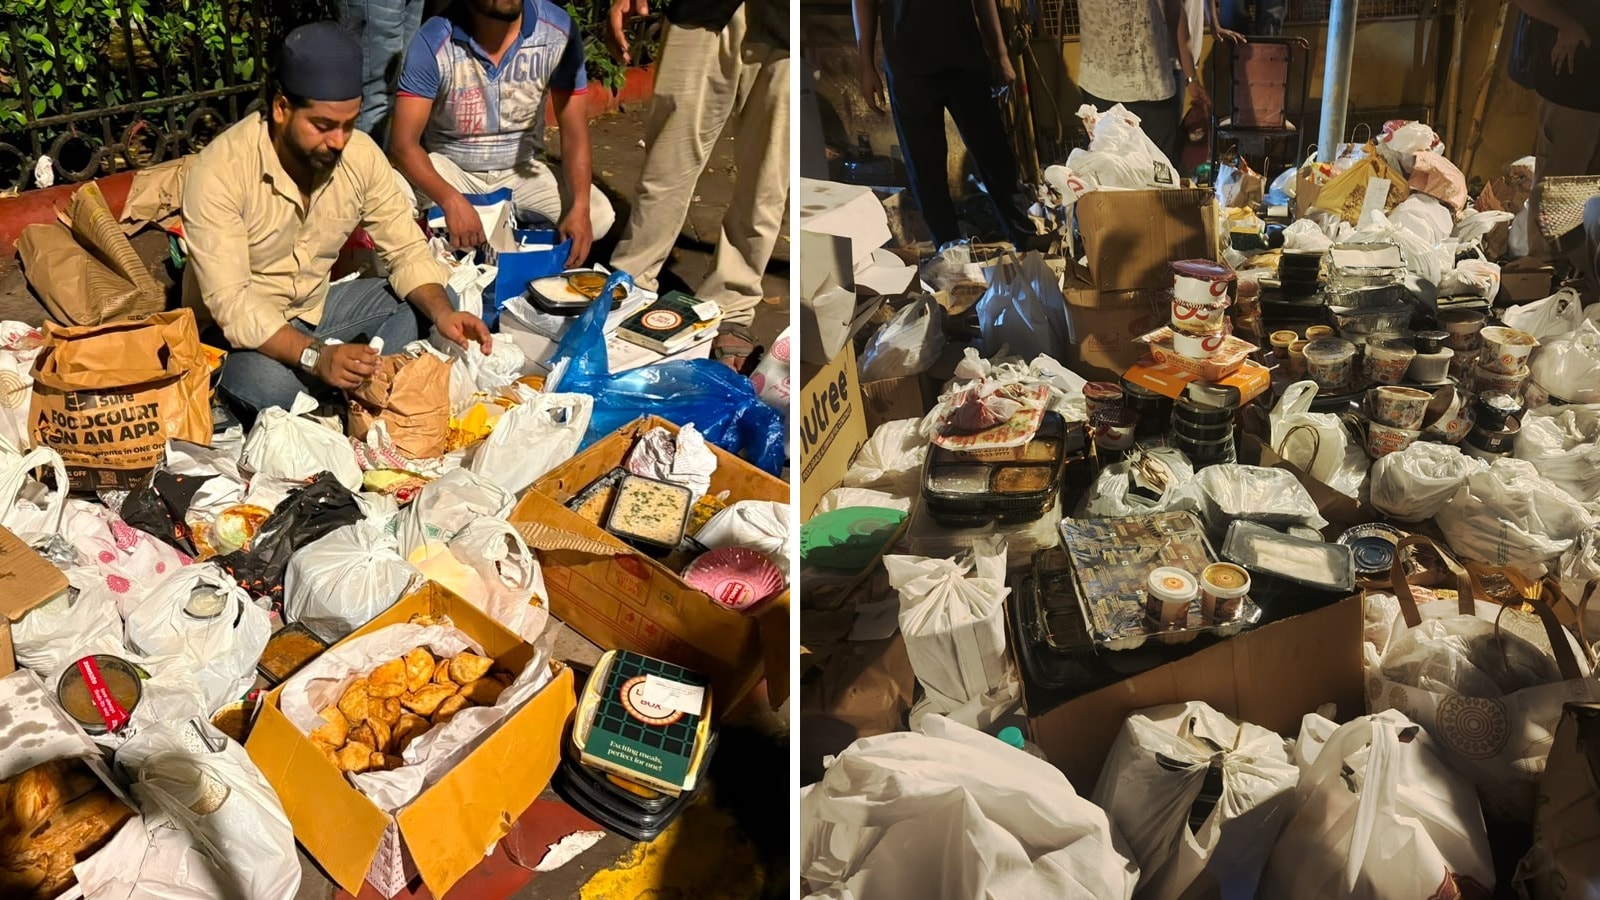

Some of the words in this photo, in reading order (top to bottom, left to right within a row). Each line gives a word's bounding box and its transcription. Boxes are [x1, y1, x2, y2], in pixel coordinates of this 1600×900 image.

[51, 403, 159, 430] FOODCOURT
[83, 429, 114, 445] AN
[120, 421, 160, 441] APP
[123, 447, 132, 455] in
[133, 445, 151, 454] ONE
[83, 660, 97, 685] zomato
[607, 748, 634, 762] perfect
[634, 756, 645, 765] for
